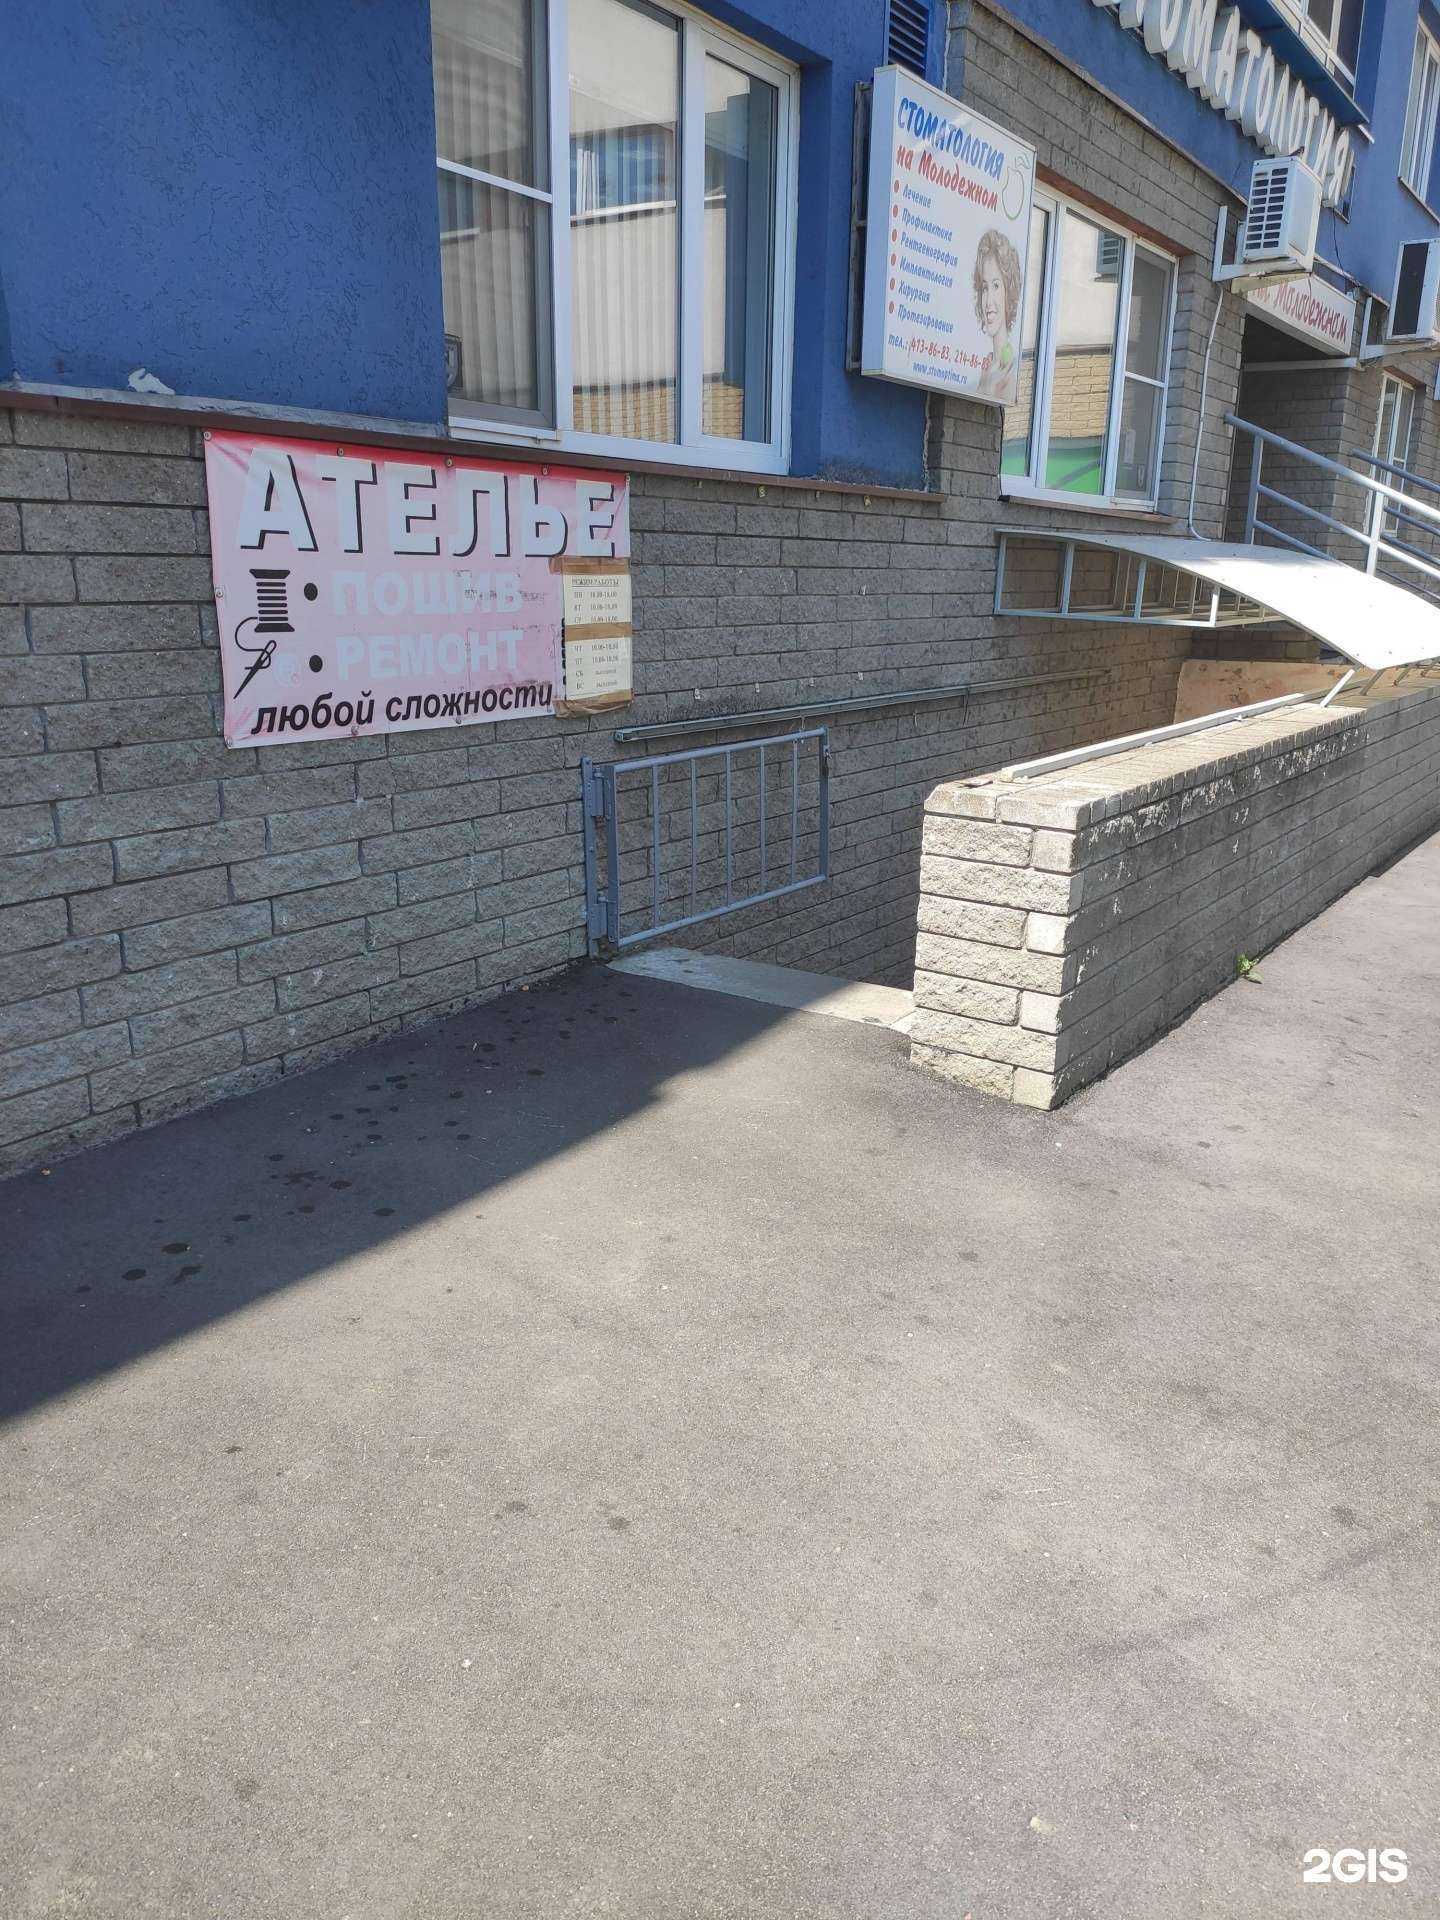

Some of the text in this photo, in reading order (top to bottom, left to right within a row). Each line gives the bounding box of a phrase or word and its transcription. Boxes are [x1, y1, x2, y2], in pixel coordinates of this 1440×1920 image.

[1092, 0, 1354, 207] ОМАТОЛОГИЯ
[898, 97, 1005, 181] СТОМАТОЛОГИЯ
[896, 145, 998, 212] на Молодежном
[903, 184, 931, 208] Лечение
[901, 207, 953, 241] Профилактика
[899, 256, 953, 288] Имплантология
[900, 231, 958, 267] Рентгенография
[898, 280, 931, 303] Хирургия
[897, 304, 954, 334] Протезирование
[236, 447, 615, 558] АТЕЛЬЕ
[332, 568, 524, 616] ПОШИВ
[335, 630, 524, 682] РЕМОНТ
[251, 684, 552, 734] любой сложности
